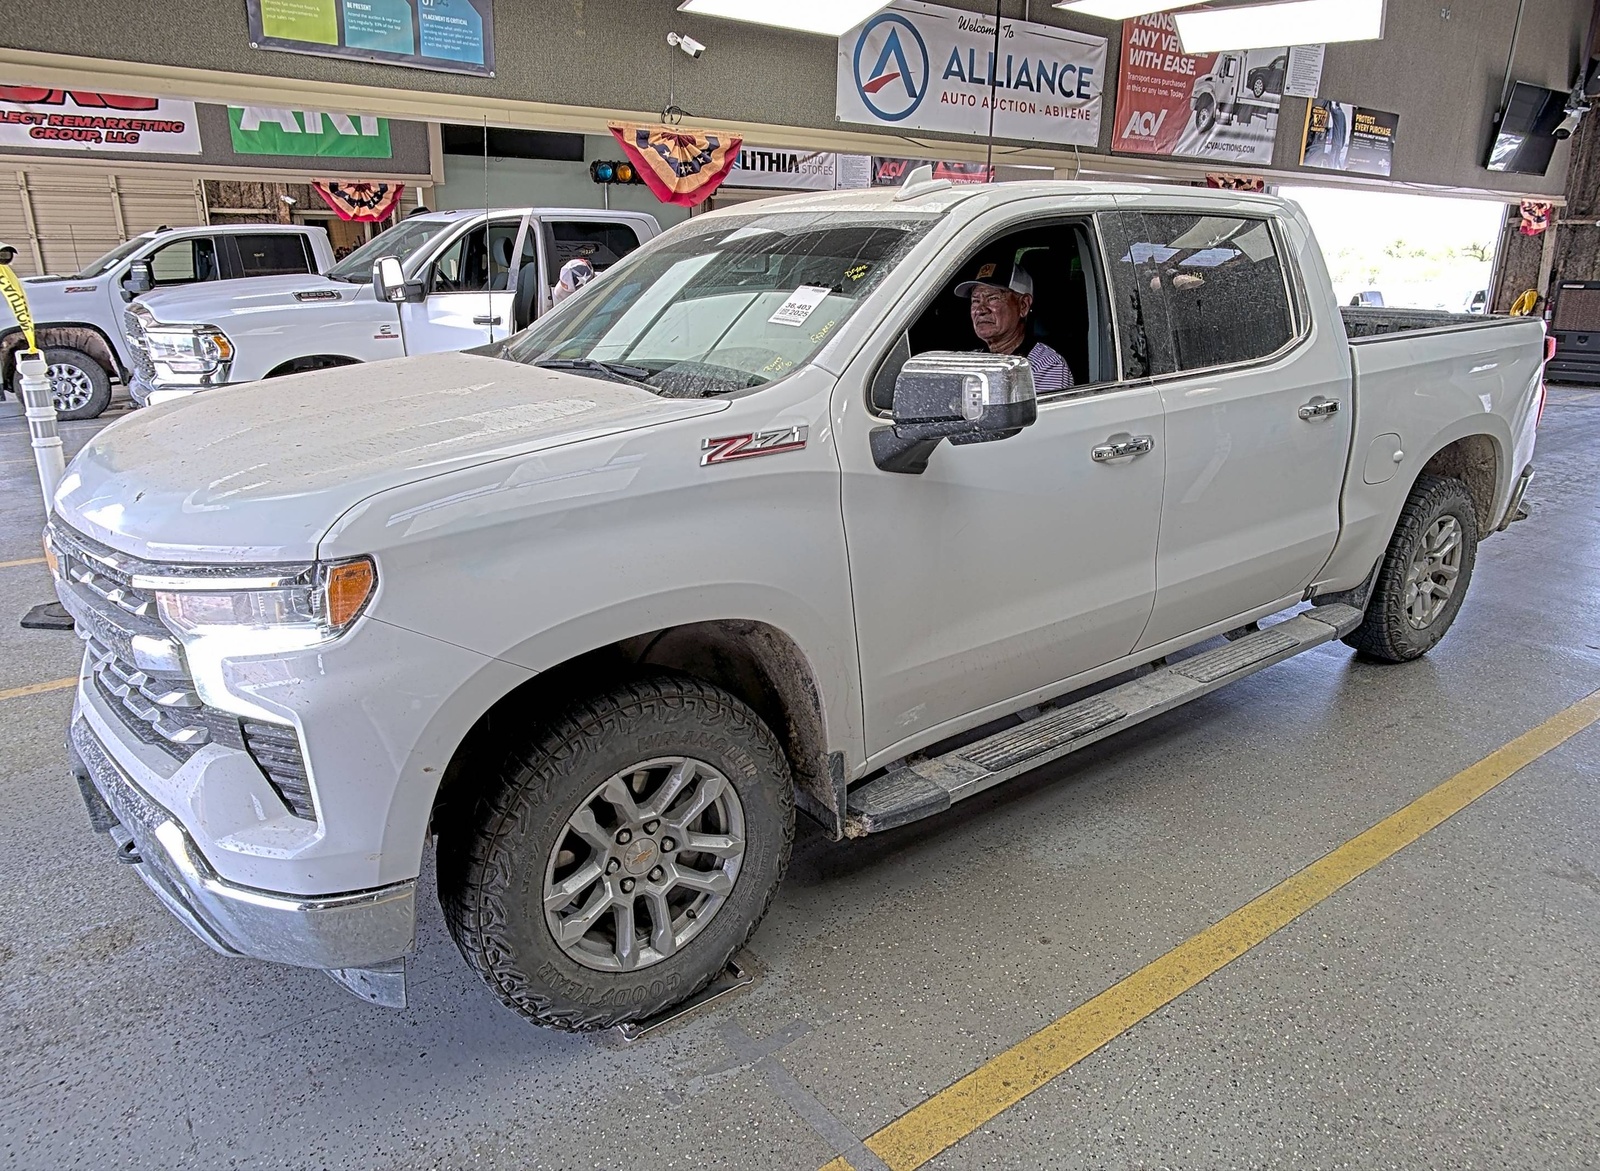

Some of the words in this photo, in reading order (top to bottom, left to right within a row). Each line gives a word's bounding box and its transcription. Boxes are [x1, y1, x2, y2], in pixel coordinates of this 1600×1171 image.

[346, 1, 352, 9] BE
[352, 2, 372, 11] PRESENT
[422, 13, 446, 22] PLACEMENT
[450, 17, 468, 26] CRITICAL
[1003, 24, 1014, 38] To
[1129, 28, 1160, 49] ANY
[1129, 48, 1164, 70] WITH
[1163, 54, 1197, 76] EASE.
[942, 45, 1094, 100] ALLIANCE
[1127, 71, 1150, 83] Transport
[1150, 76, 1161, 85] cars
[1161, 77, 1187, 89] purchased
[1131, 84, 1141, 93] this
[1148, 87, 1157, 96] any
[1157, 88, 1169, 96] lane.
[940, 91, 977, 107] AUTO
[981, 96, 1036, 114] AUCTION
[1044, 104, 1091, 121] ABILENE
[48, 113, 185, 133] REMARKETING
[1121, 108, 1168, 139] ACV
[1355, 113, 1376, 125] PROTECT
[29, 127, 103, 143] GROUP,
[105, 131, 140, 144] LLC
[1354, 122, 1369, 132] EVERY
[1369, 124, 1392, 136] PURCHASE
[741, 150, 800, 174] LITHIA
[802, 154, 824, 165] AUTO
[801, 165, 834, 176] STORES
[700, 424, 809, 468] Z71
